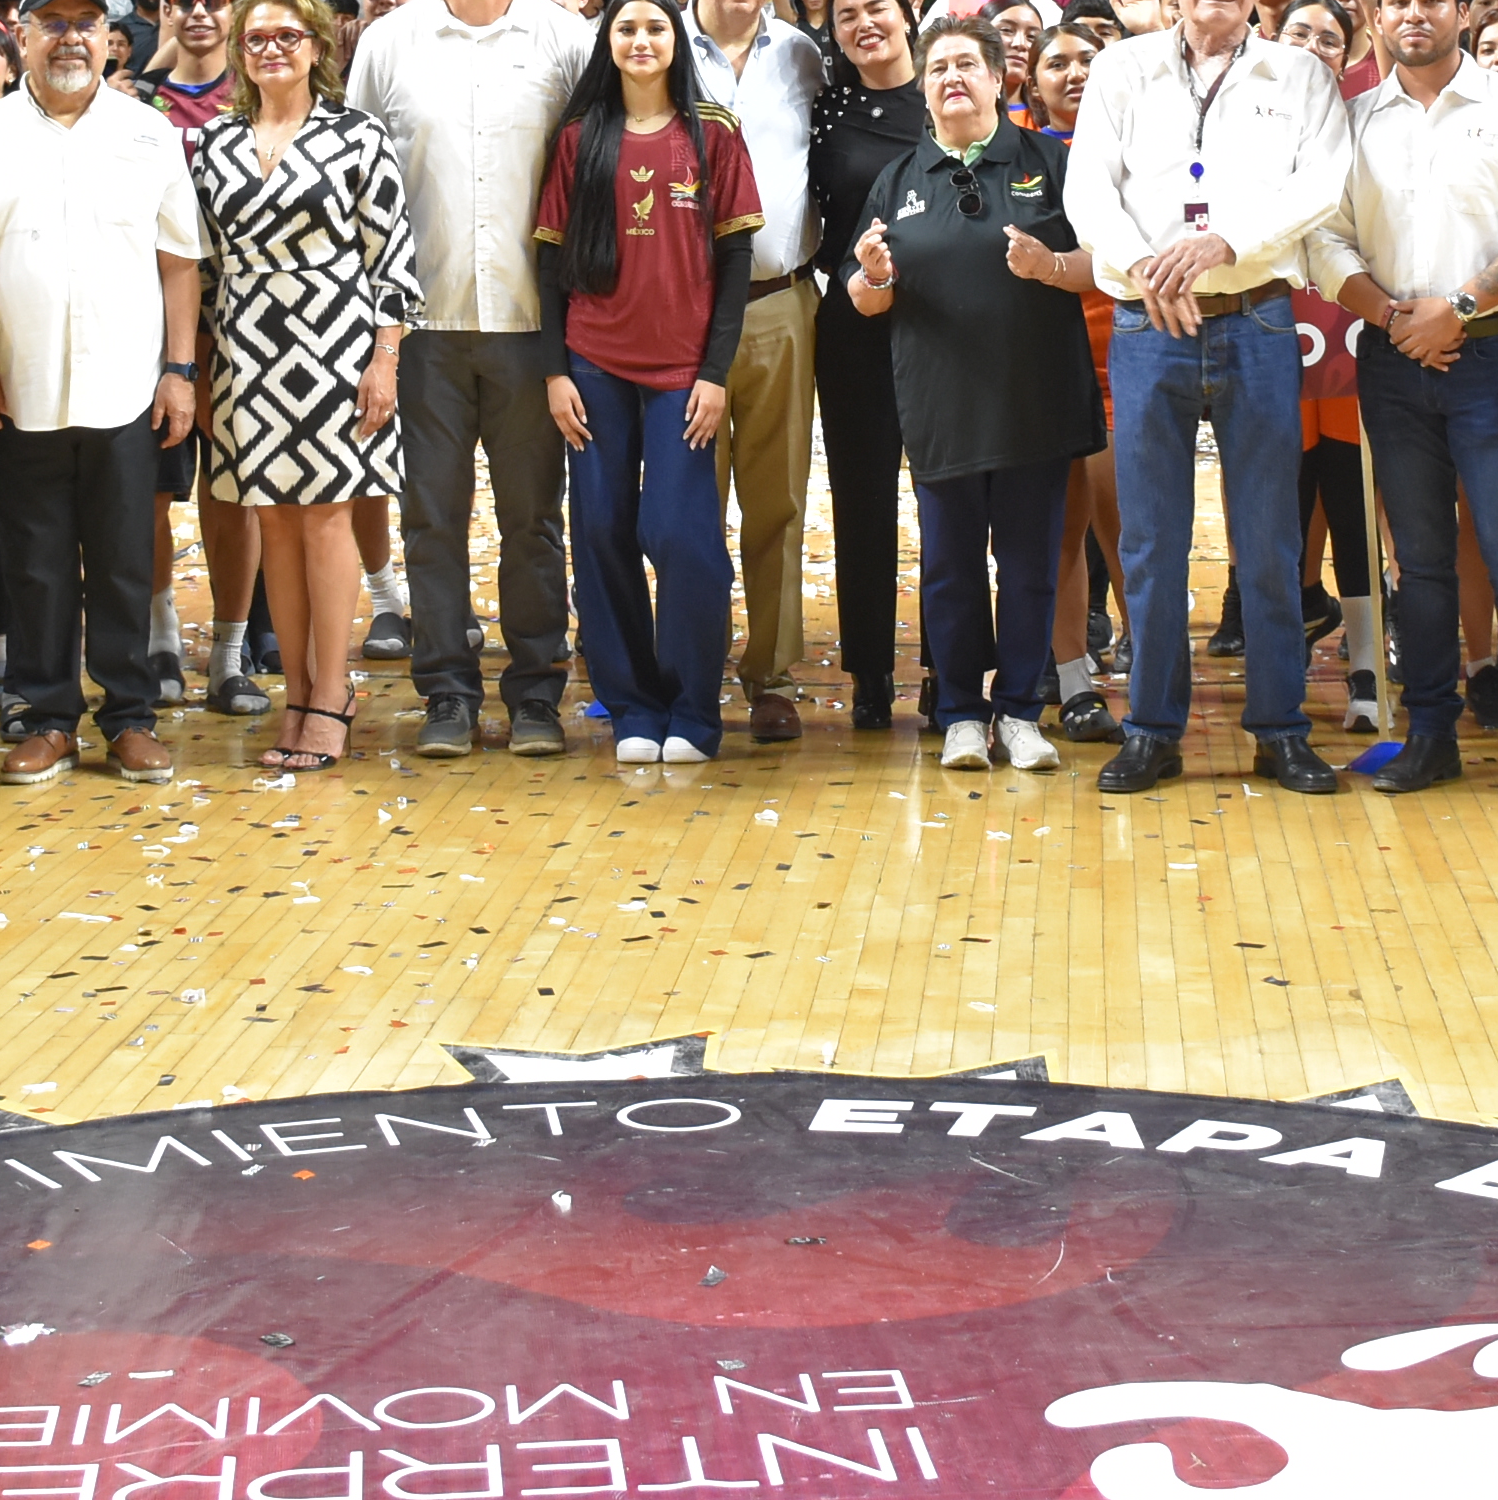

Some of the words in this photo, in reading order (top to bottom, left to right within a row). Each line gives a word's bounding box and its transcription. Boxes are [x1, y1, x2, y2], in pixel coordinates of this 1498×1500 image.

[626, 227, 655, 236] MÉXICO
[810, 1097, 1385, 1179] ETAPA
[716, 1370, 914, 1412] EN
